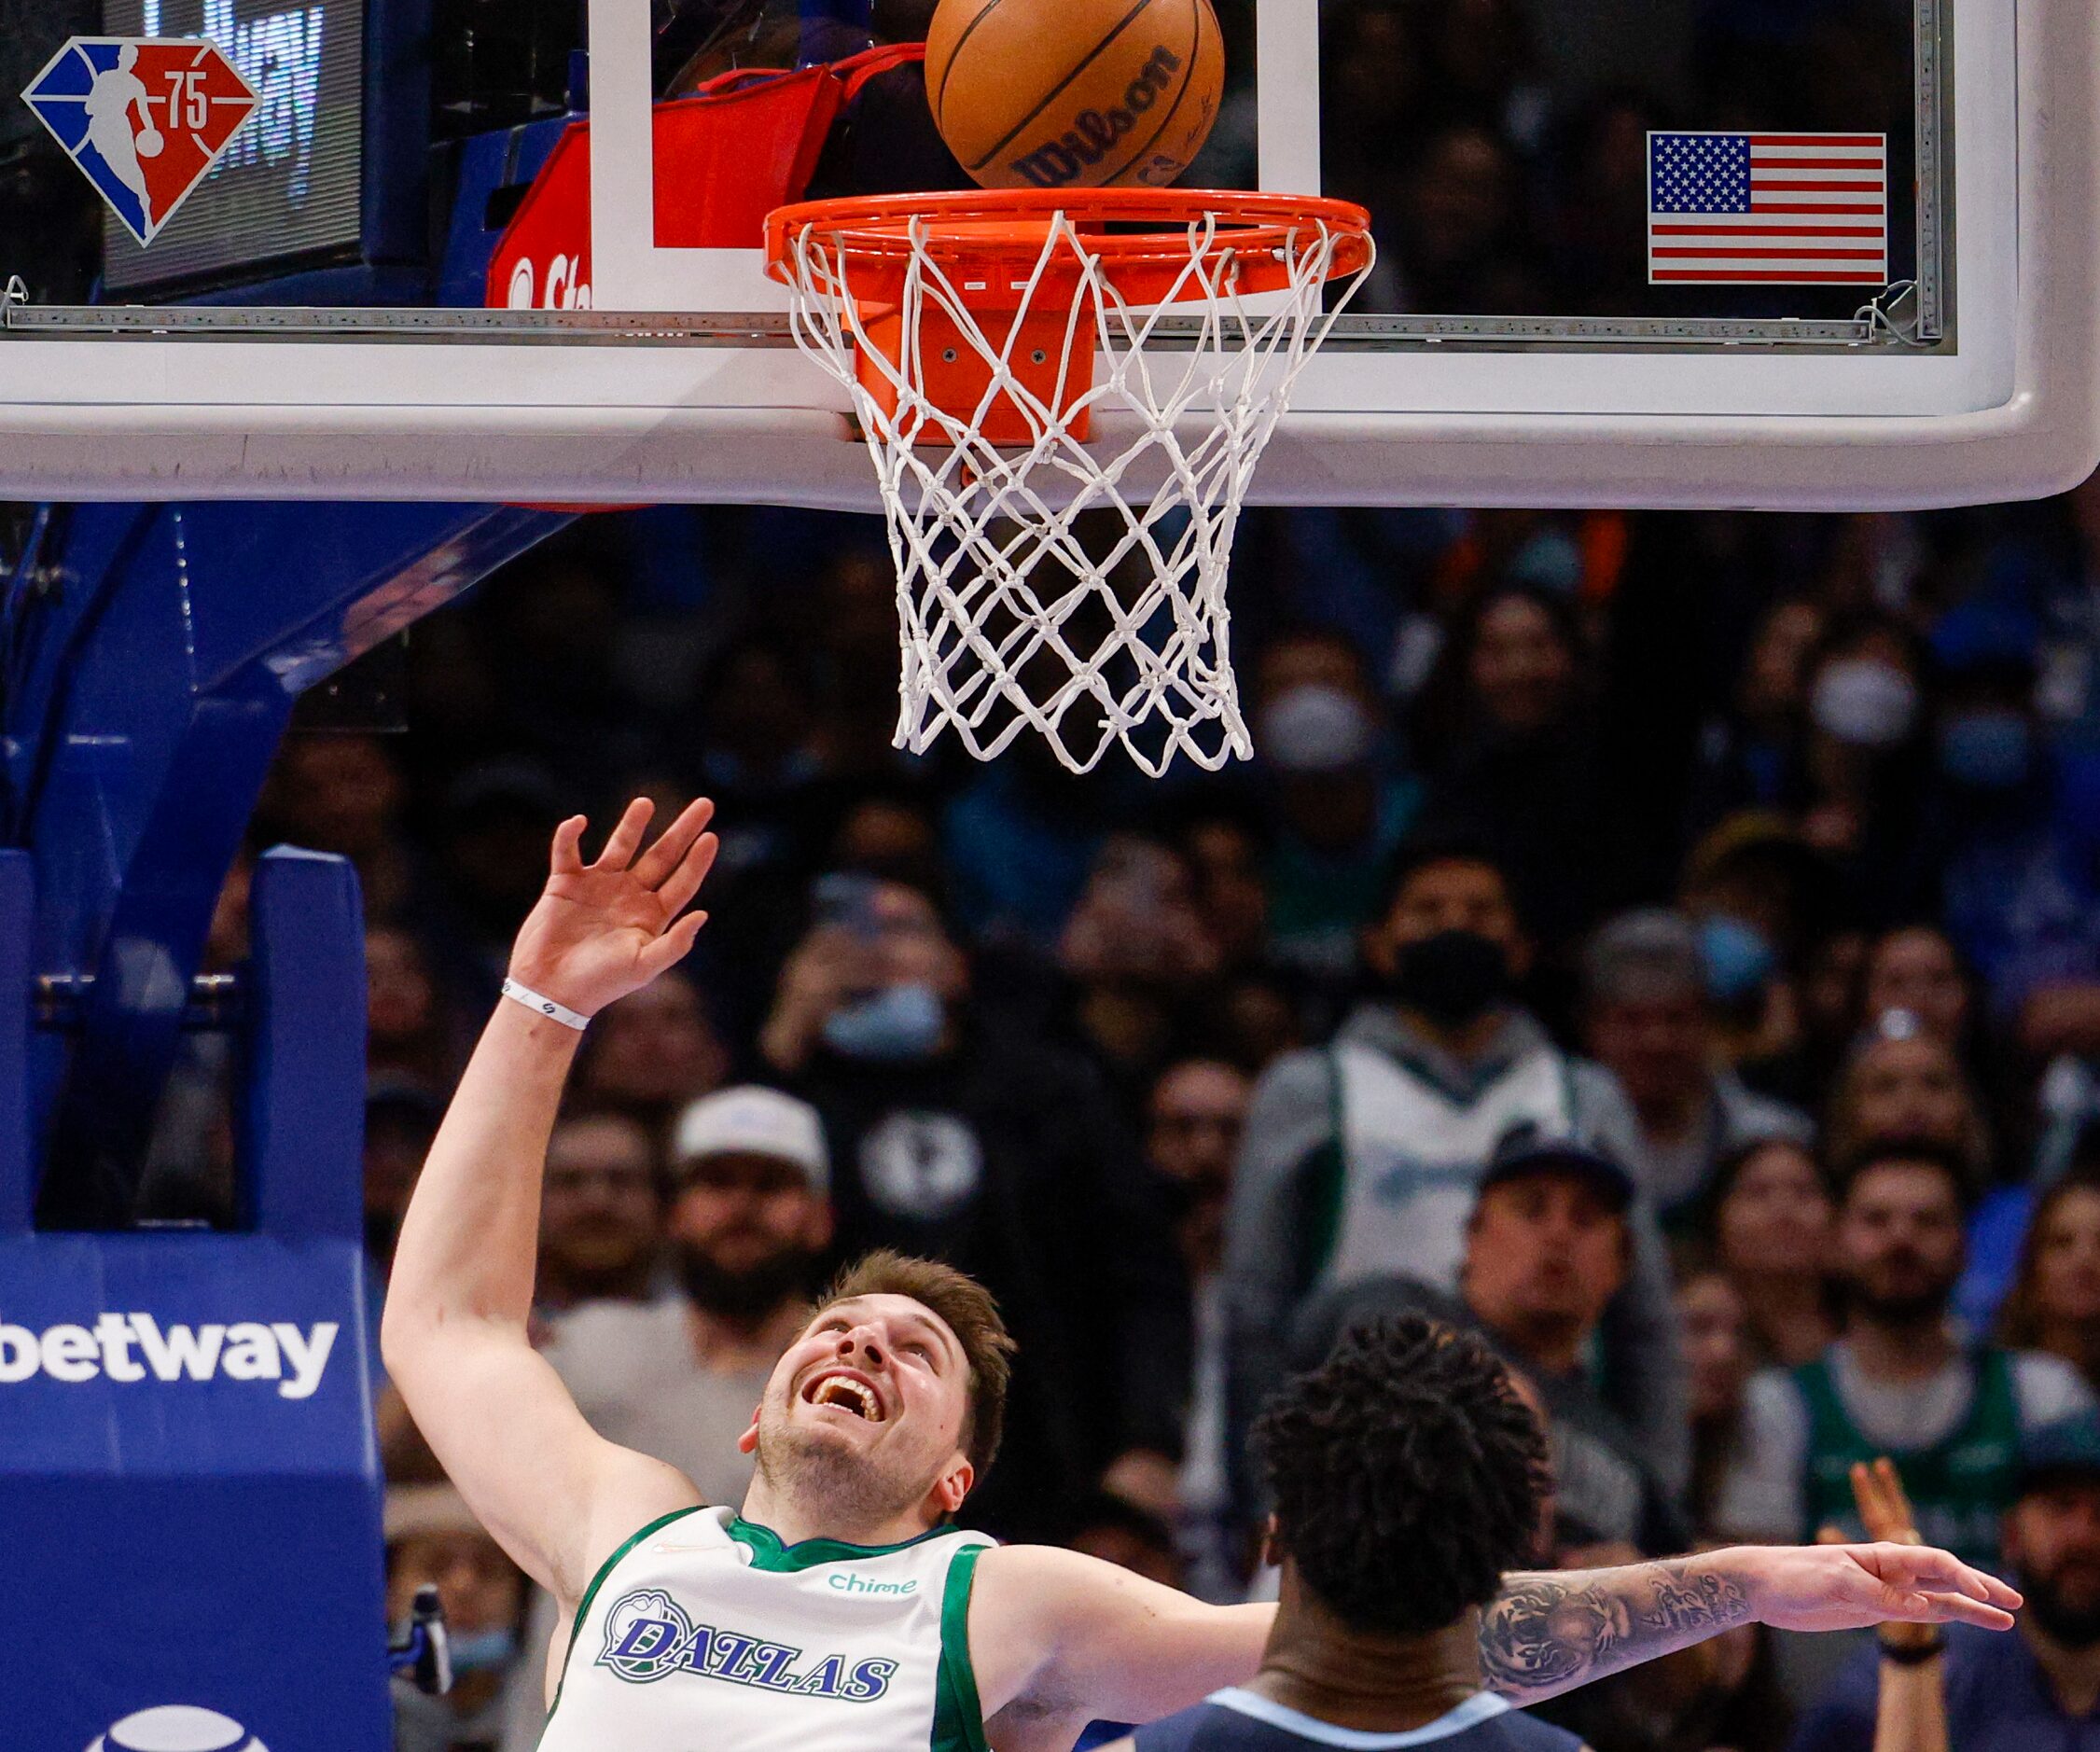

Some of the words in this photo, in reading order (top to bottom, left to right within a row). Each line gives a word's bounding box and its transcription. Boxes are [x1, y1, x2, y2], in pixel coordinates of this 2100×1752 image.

[164, 71, 208, 130] 75
[1008, 45, 1182, 188] Wilson
[594, 1614, 899, 1703] DALLAS
